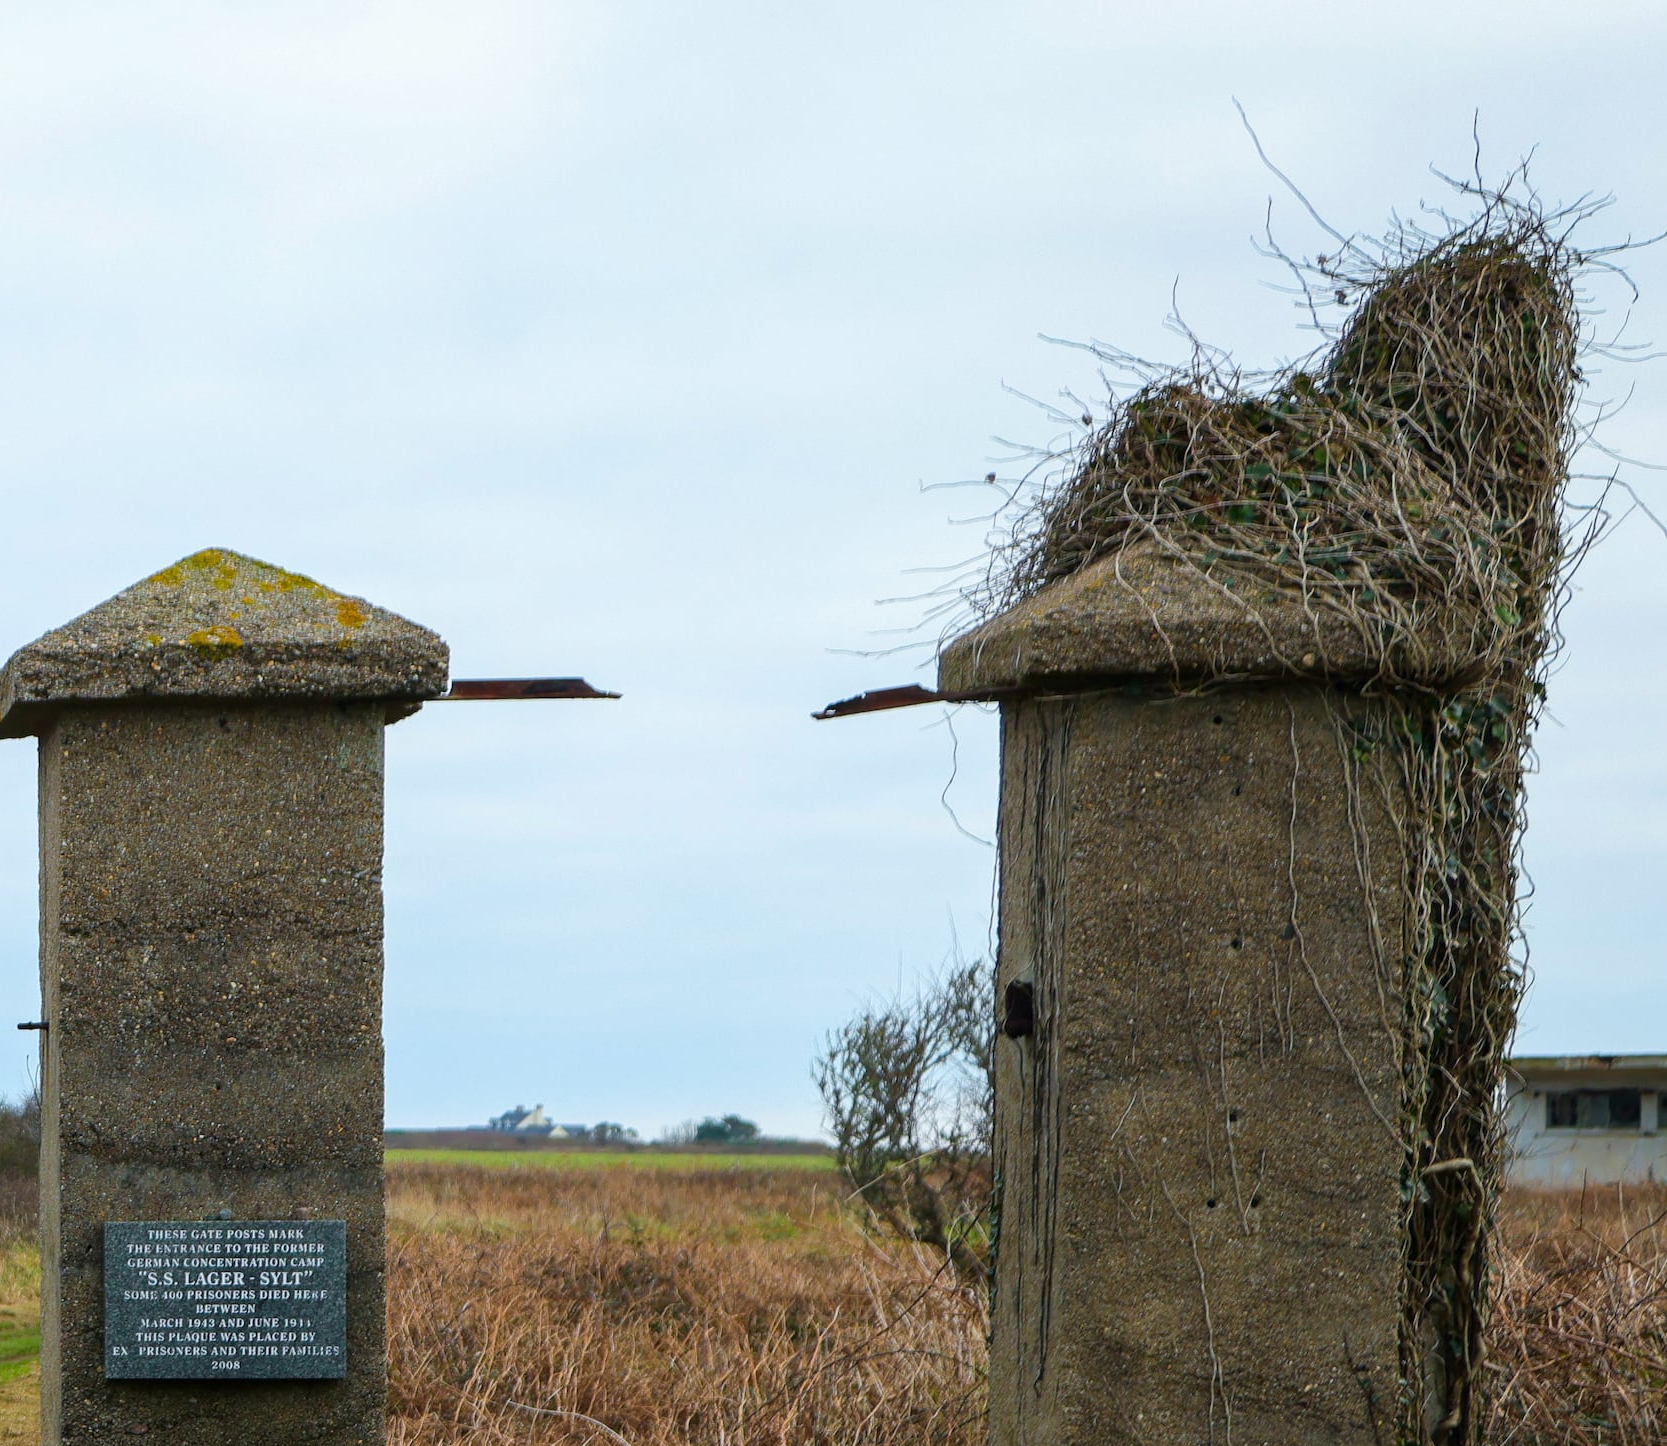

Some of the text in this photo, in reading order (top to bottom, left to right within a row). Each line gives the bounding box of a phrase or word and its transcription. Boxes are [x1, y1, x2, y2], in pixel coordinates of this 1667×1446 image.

[148, 1229, 304, 1240] THESE GATE POSTS MARK
[127, 1243, 324, 1254] THE ENTRANCE TO THE FORMER
[127, 1258, 324, 1268] GERMAN CONCENTRATION CAMP
[185, 1271, 244, 1286] LAGER
[124, 1290, 327, 1300] SOME 400 PRISONERS DIED HERE
[196, 1304, 256, 1314] BETWEEN
[141, 1318, 183, 1328] MARCH
[188, 1318, 215, 1328] 1943
[219, 1318, 244, 1328] AND
[248, 1318, 279, 1328] JUNE
[136, 1332, 316, 1343] THIS PLAQUE WAS PLACED BY
[139, 1346, 207, 1356] PRISONERS
[211, 1346, 236, 1356] AND
[240, 1346, 278, 1356] THEIR
[282, 1346, 340, 1356] FAMILIES
[212, 1360, 240, 1370] 2008
